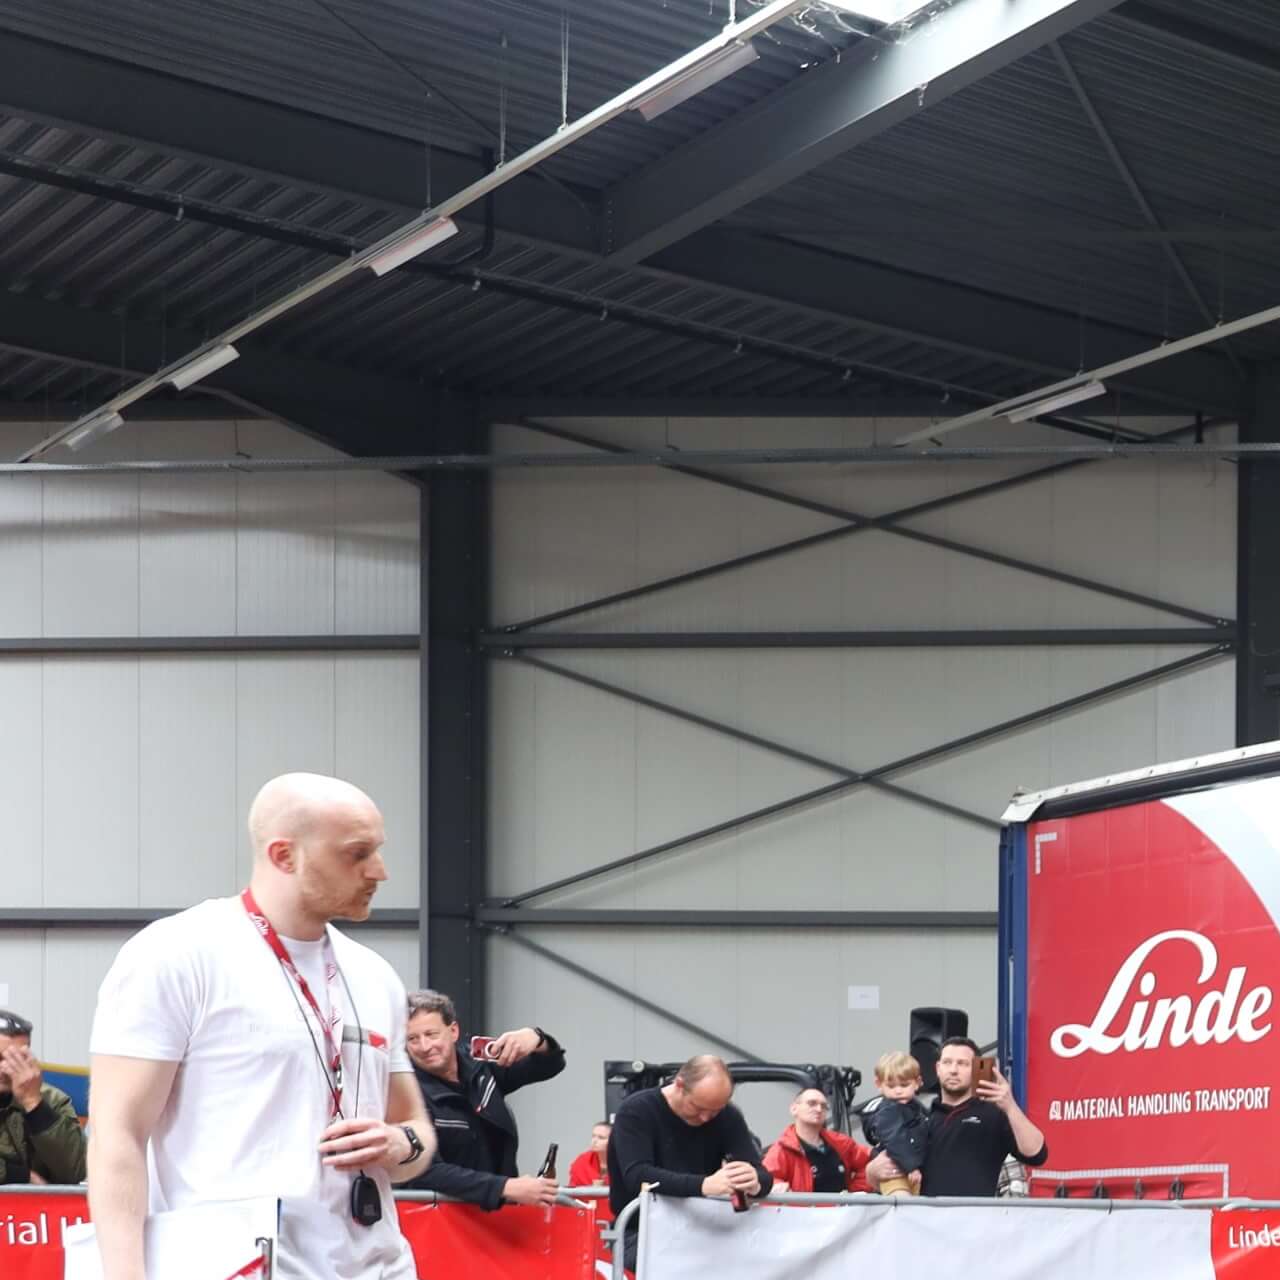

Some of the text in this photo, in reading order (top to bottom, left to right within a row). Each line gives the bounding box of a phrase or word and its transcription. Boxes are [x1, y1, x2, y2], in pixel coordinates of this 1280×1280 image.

[1050, 929, 1272, 1058] Linde
[1063, 1097, 1124, 1120] MATERIAL
[1127, 1091, 1191, 1117] HANDLING
[1195, 1086, 1271, 1112] TRANSPORT
[0, 1212, 48, 1245] ial
